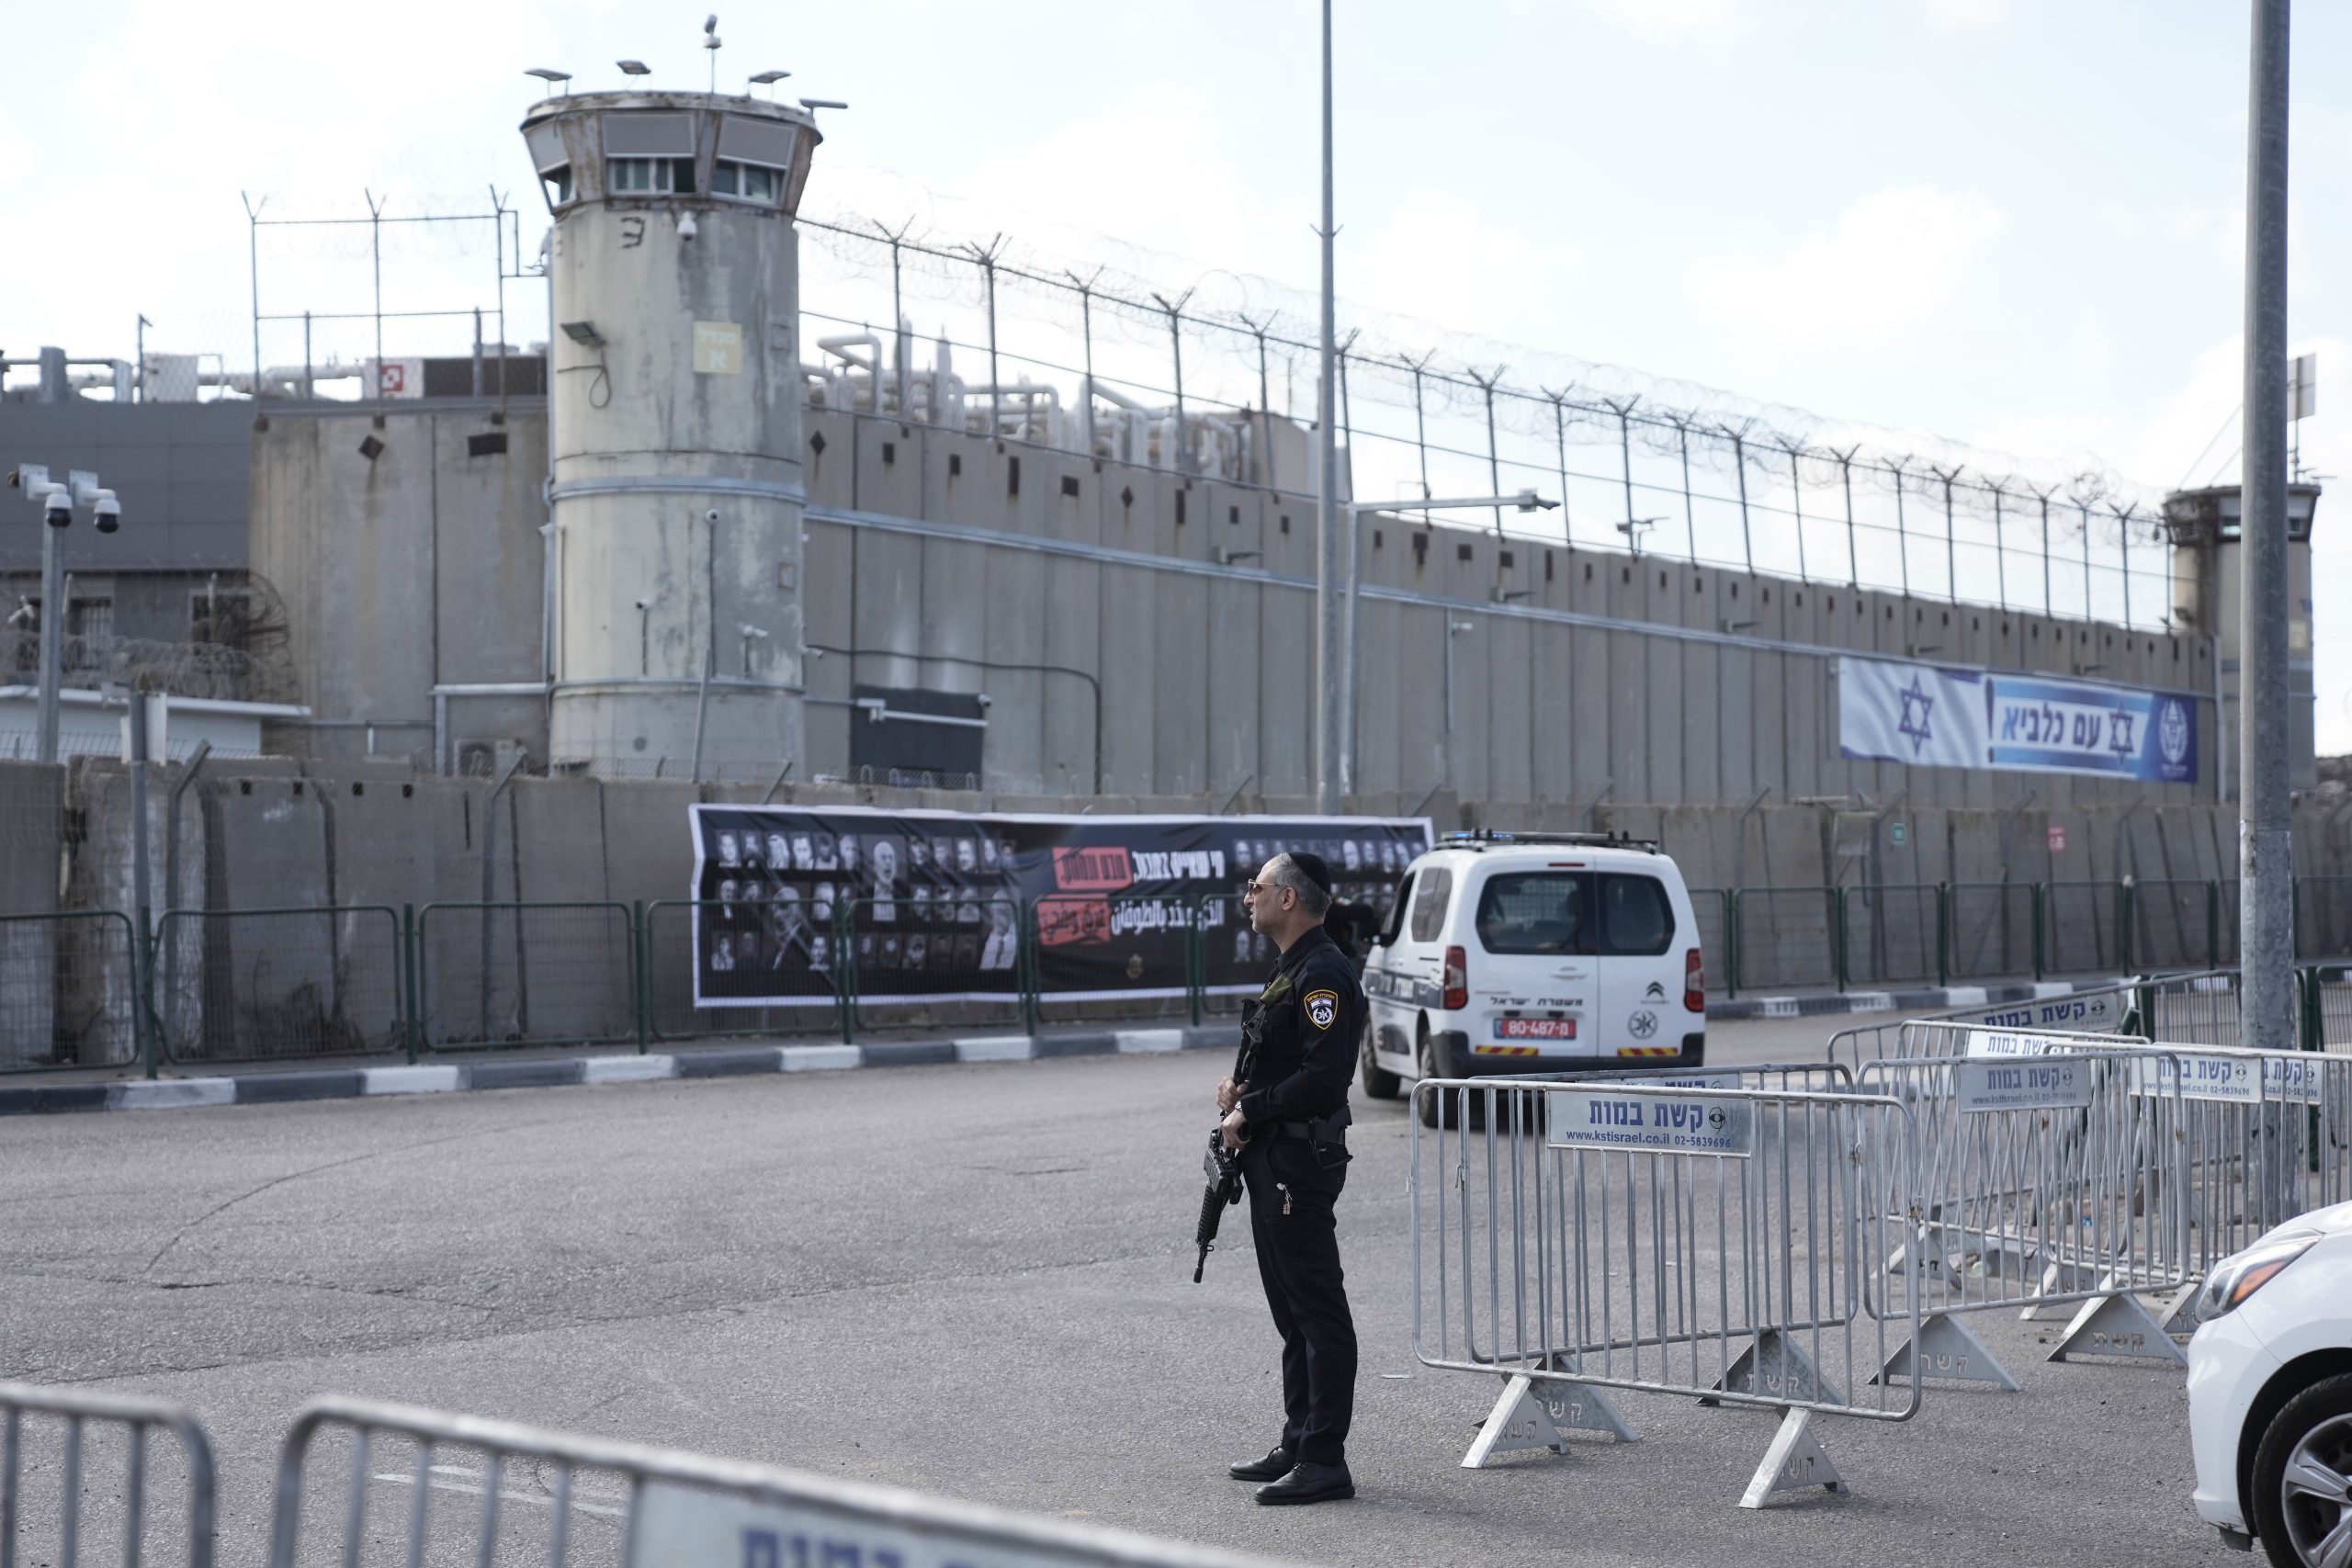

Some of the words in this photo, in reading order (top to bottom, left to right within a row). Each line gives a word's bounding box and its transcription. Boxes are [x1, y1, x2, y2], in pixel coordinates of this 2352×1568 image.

[2002, 702, 2064, 745] כלביא
[2073, 712, 2101, 750] עם
[1489, 997, 1531, 1006] ישראל
[1537, 998, 1583, 1007] משטרת
[2041, 1001, 2086, 1023] קשת
[1987, 1035, 2018, 1055] במות
[1987, 1068, 2022, 1090] במות
[2028, 1066, 2061, 1090] קשת
[2198, 1060, 2232, 1084] קשת
[2210, 1086, 2250, 1096] 02-5839696
[1589, 1100, 1644, 1126] במות
[1655, 1102, 1704, 1134] קשת
[1566, 1130, 1670, 1145] www.kstisrael.co.il
[1675, 1137, 1731, 1149] 02-5839696
[2093, 1331, 2144, 1353] קשת
